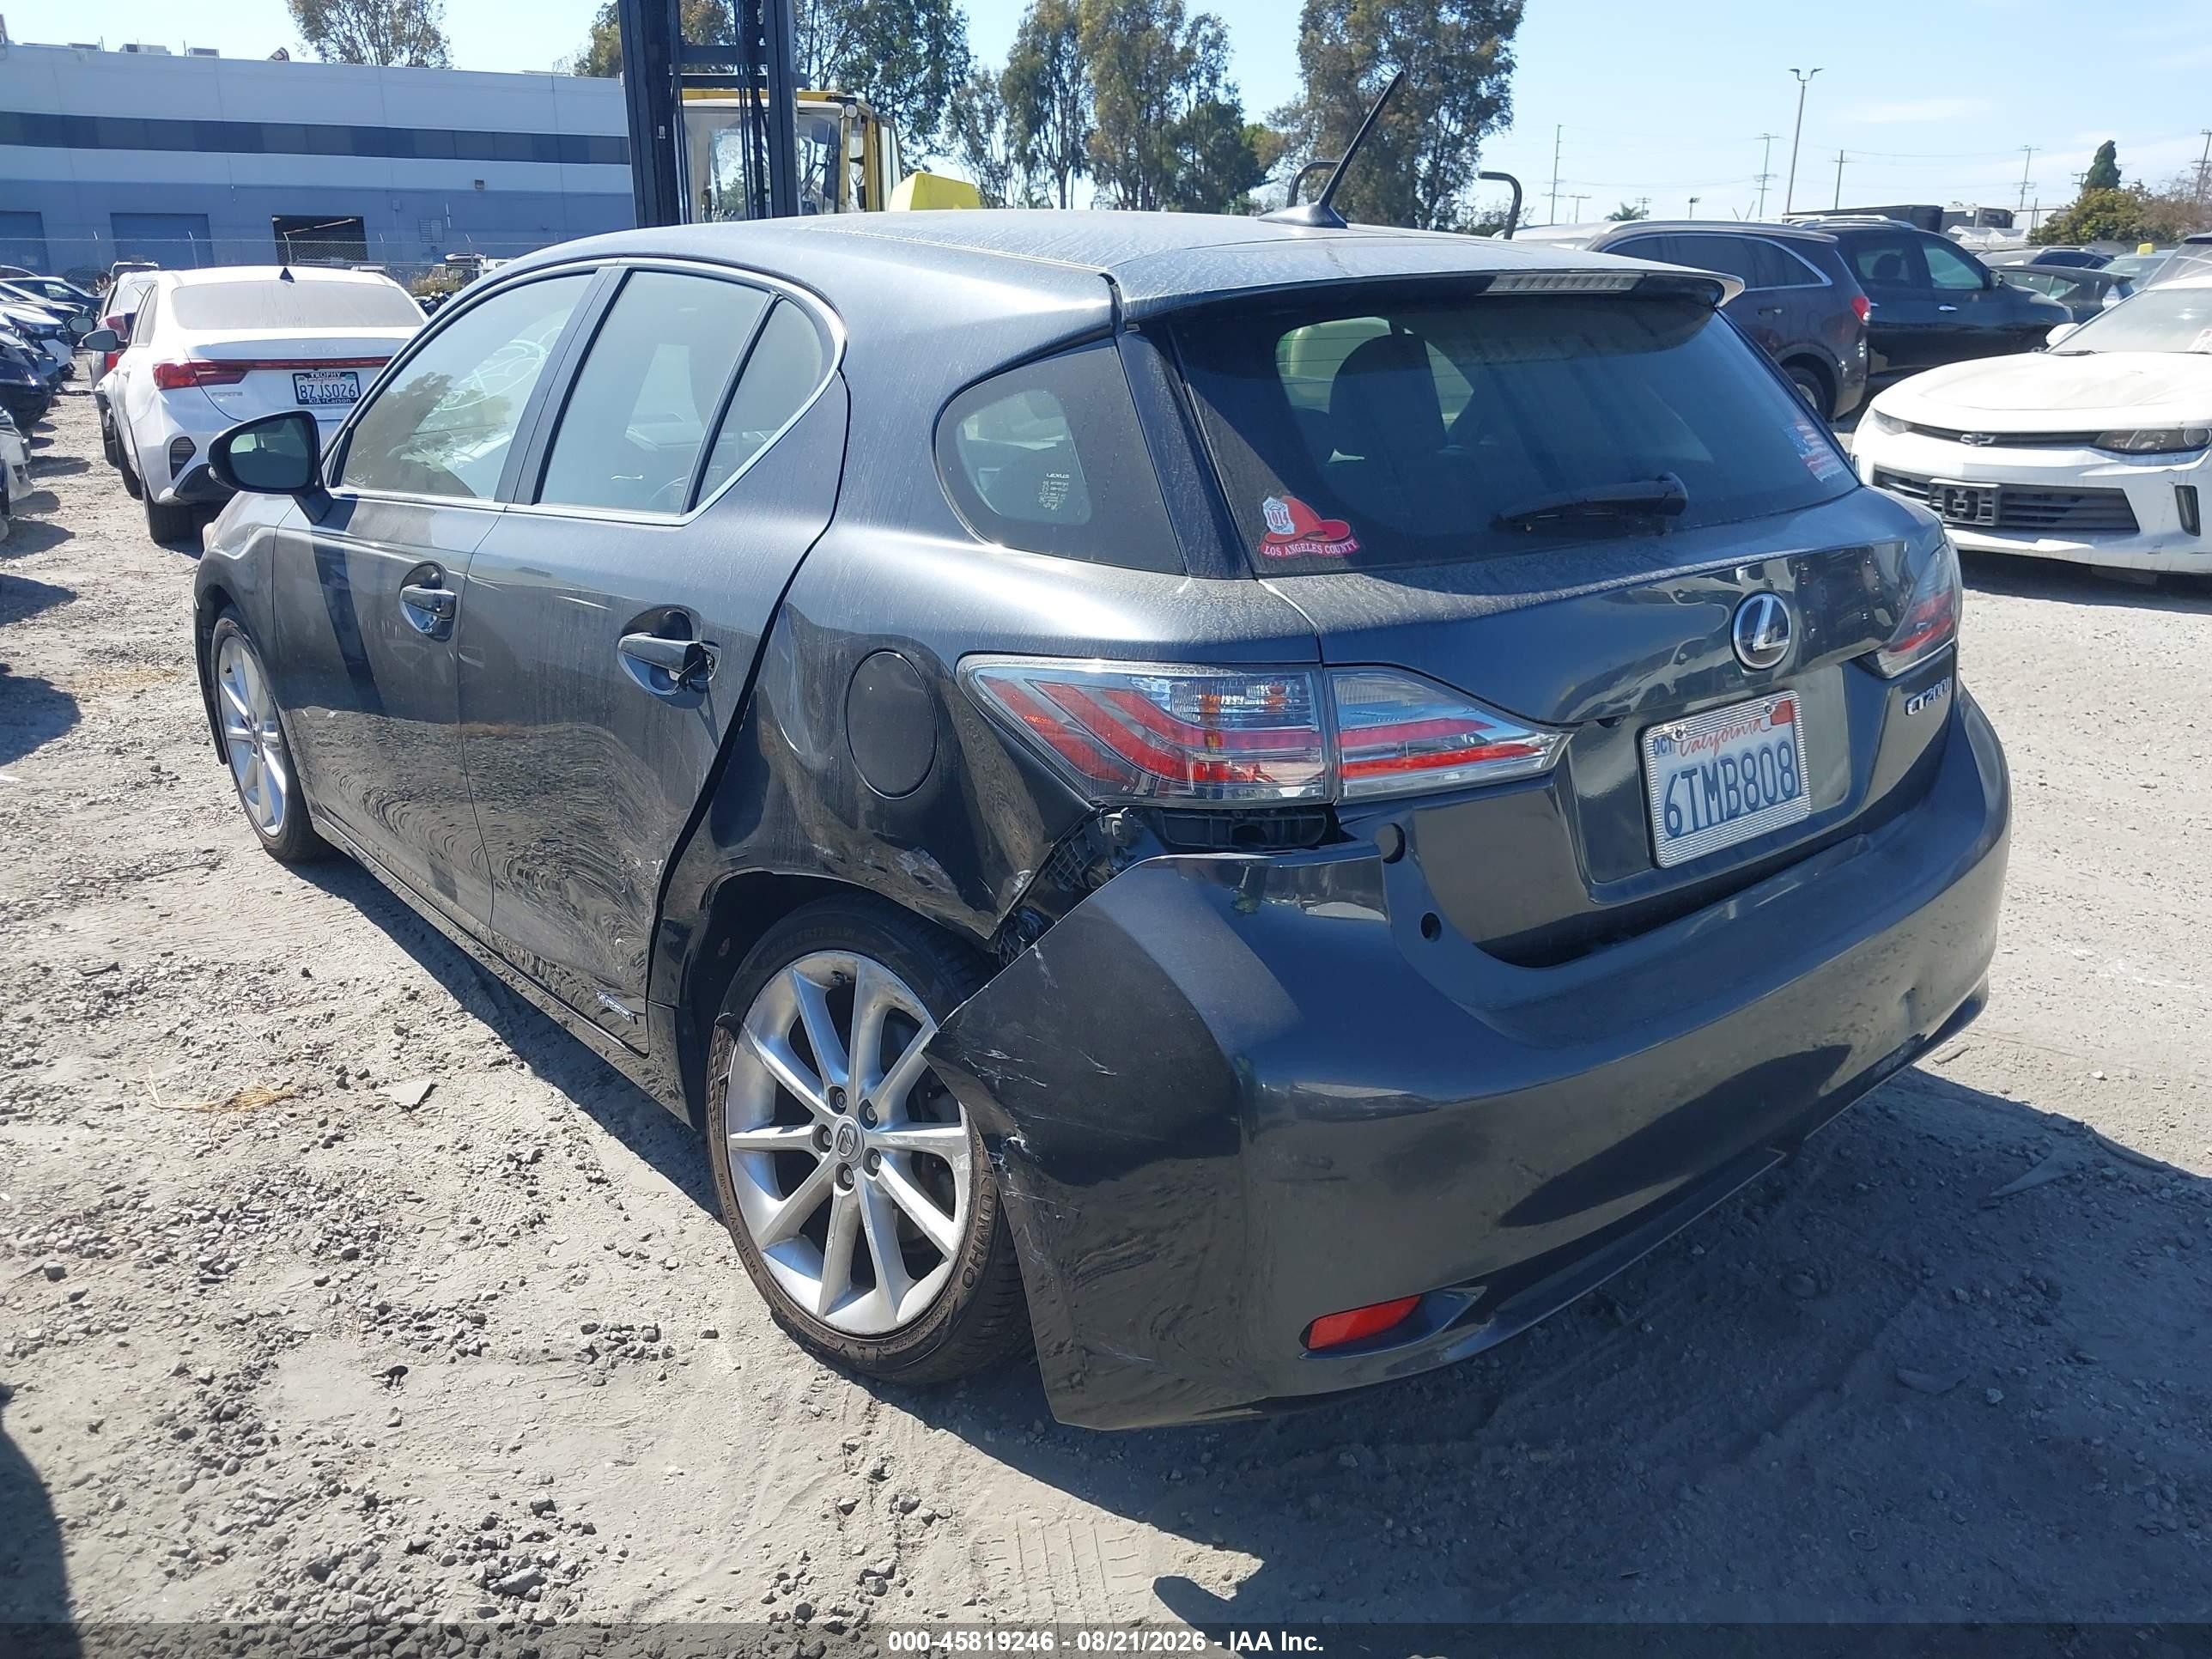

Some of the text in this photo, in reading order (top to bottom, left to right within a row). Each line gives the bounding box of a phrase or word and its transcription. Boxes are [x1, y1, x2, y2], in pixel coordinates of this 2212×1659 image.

[299, 383, 356, 399] 8ZJS026
[1264, 539, 1358, 556] LOS ANGELES COUNTY
[1679, 719, 1773, 757] California
[1663, 740, 1796, 838] 6TMB808
[961, 1168, 994, 1289] KUMHO
